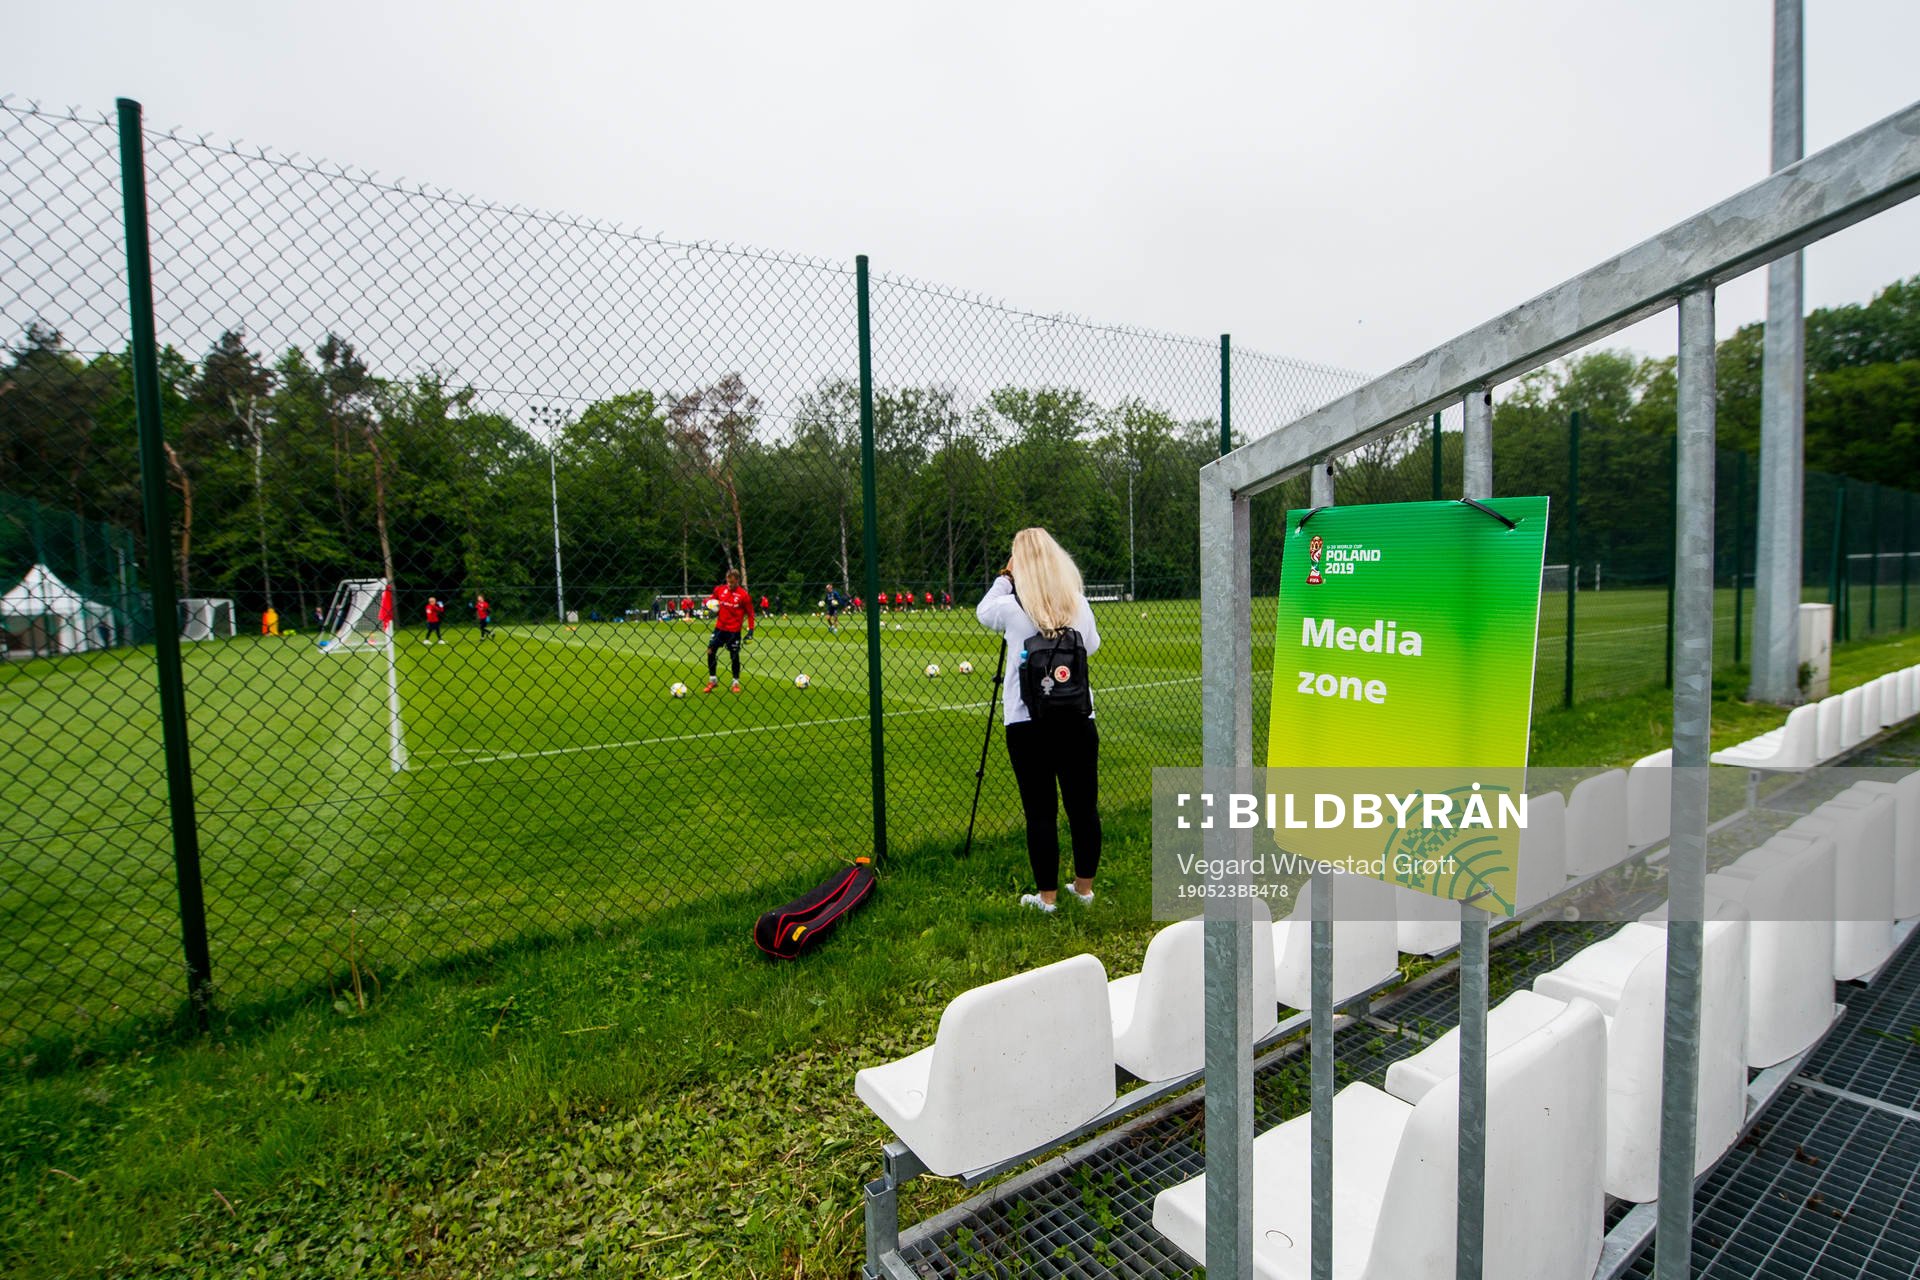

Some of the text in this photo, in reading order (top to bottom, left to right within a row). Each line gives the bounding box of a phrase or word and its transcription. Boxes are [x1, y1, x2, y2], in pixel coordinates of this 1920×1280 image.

[1326, 550, 1381, 561] POLAND
[1325, 563, 1354, 574] 2019
[1302, 617, 1422, 656] Media
[1298, 671, 1387, 704] zone
